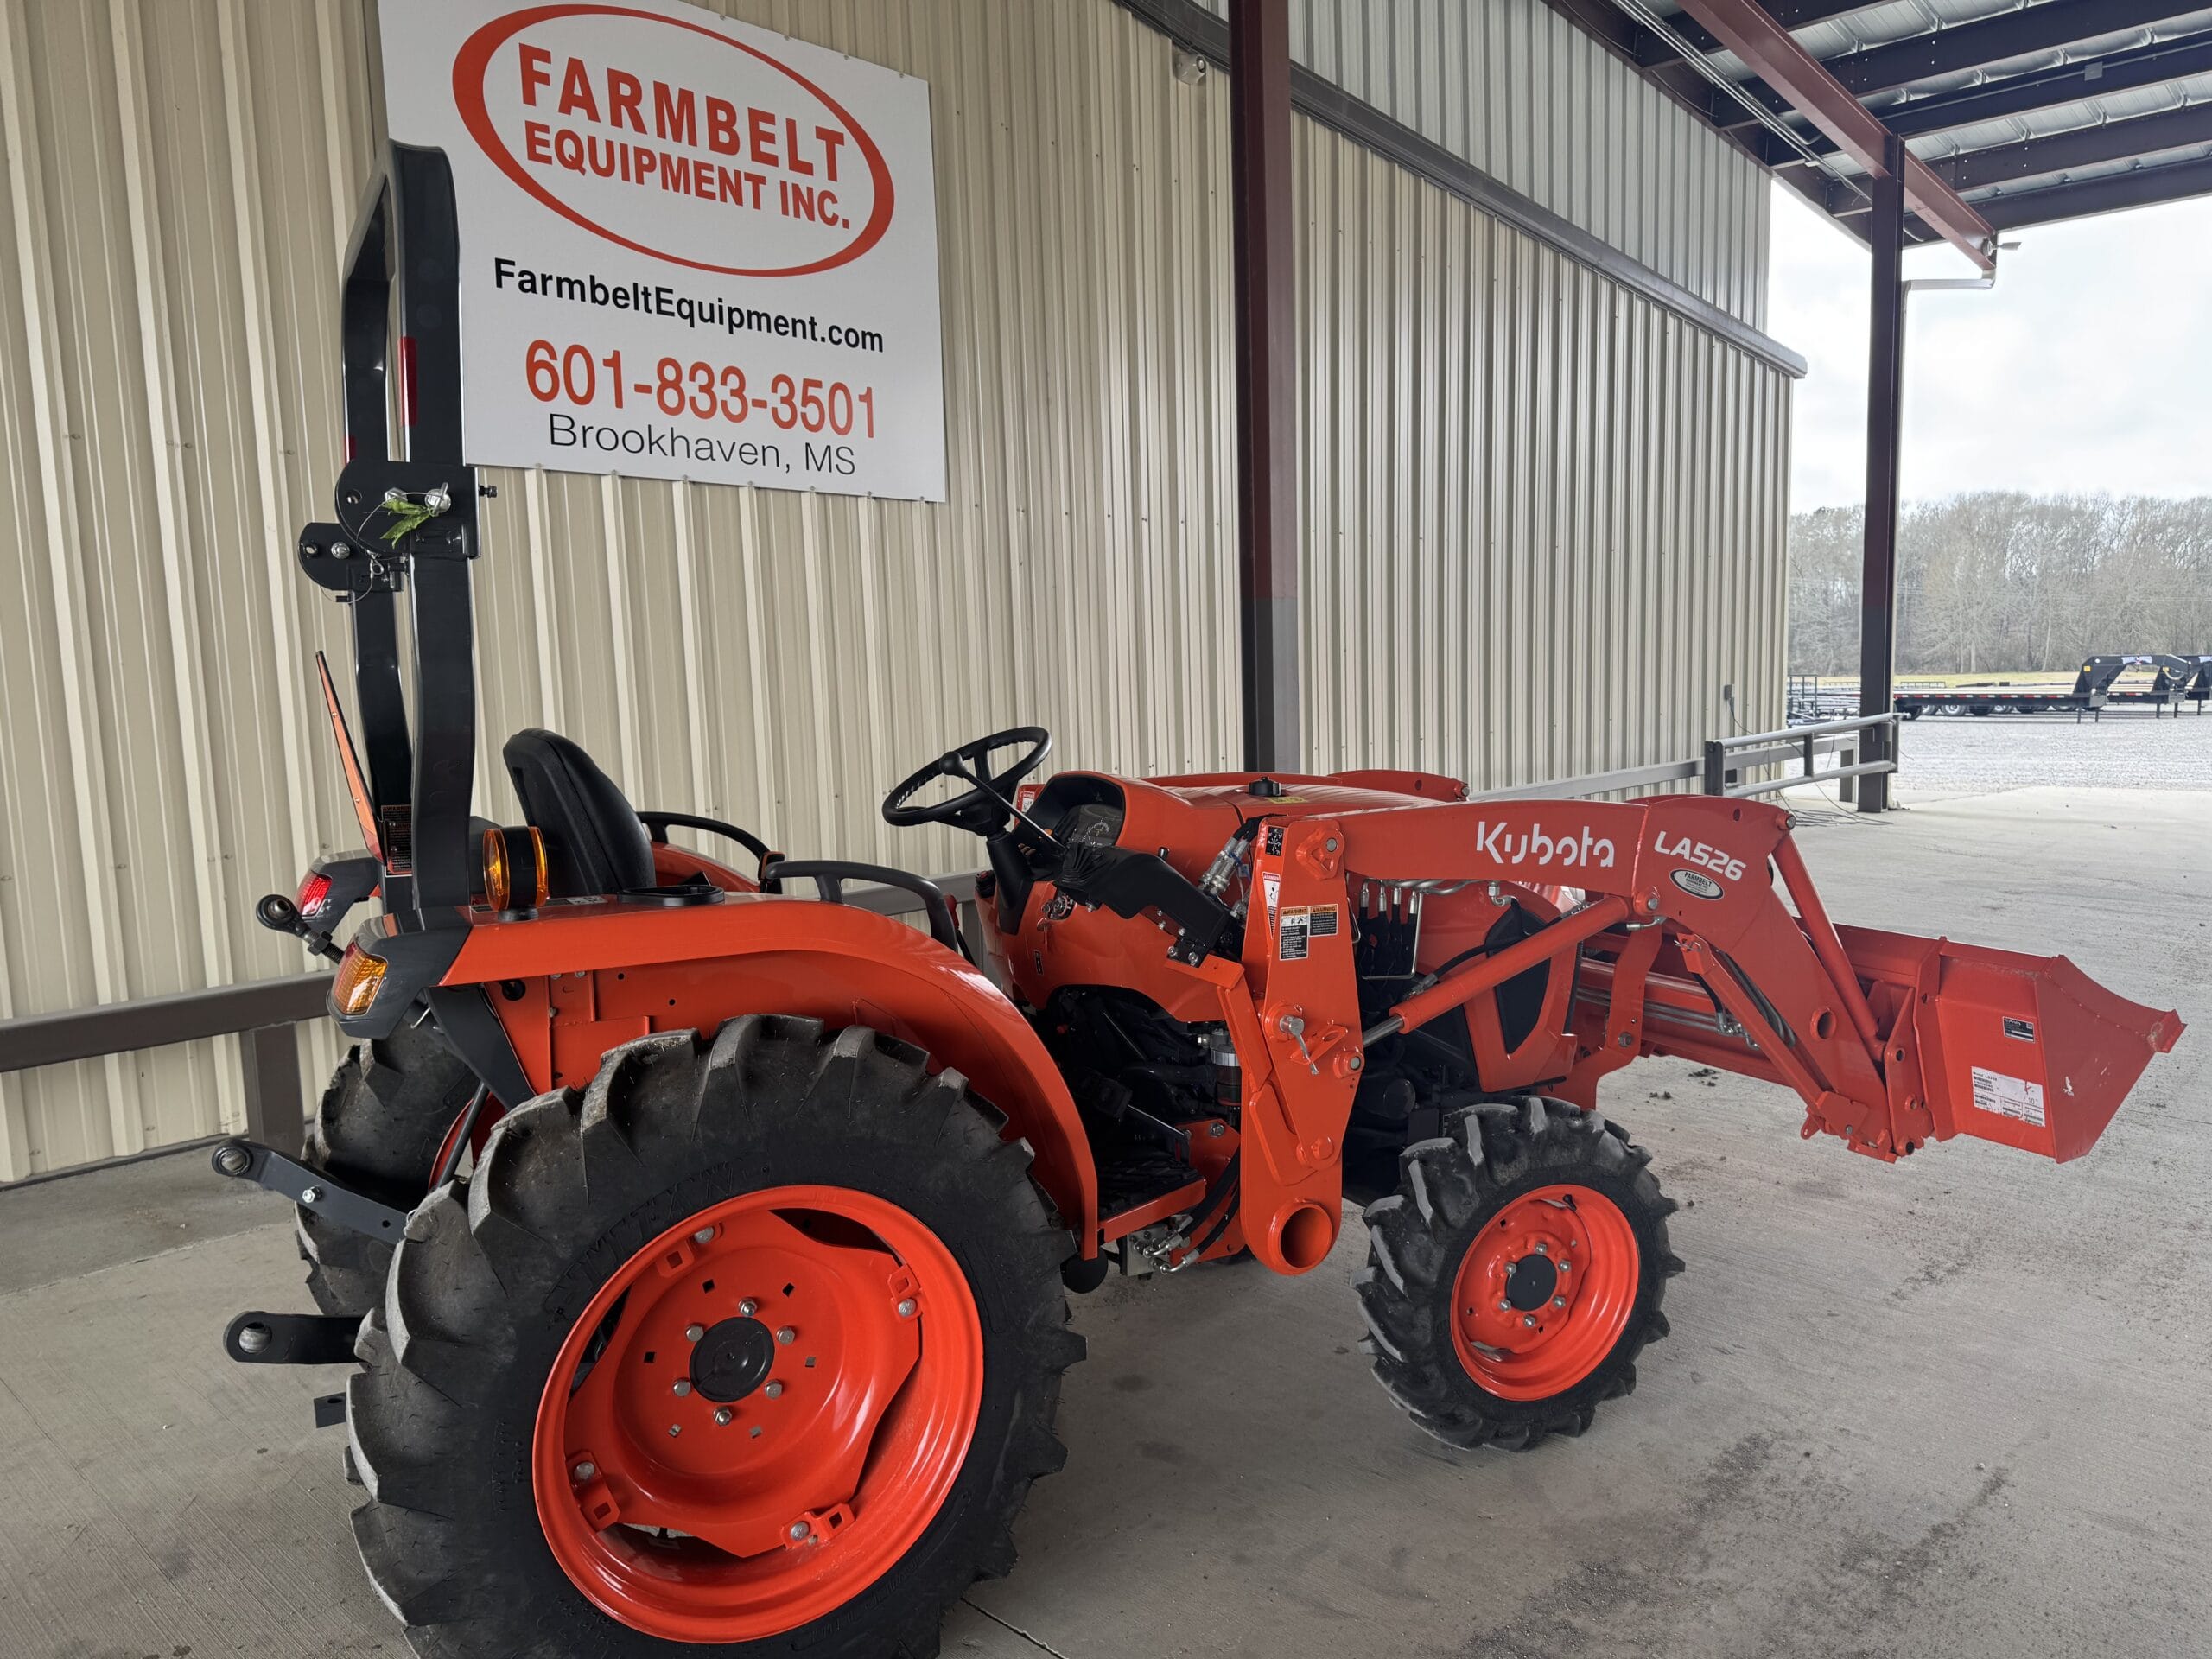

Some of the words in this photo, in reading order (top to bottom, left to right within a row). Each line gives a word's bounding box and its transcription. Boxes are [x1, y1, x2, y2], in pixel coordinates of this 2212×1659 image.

[519, 43, 845, 181] FARMBELT
[524, 121, 766, 210] EQUIPMENT
[779, 180, 849, 229] INC.
[494, 257, 884, 353] FarmbeltEquipment.com
[525, 339, 874, 438] 601-833-3501
[550, 413, 791, 474] Brookhaven,
[804, 442, 855, 475] MS
[1476, 821, 1615, 867] Kubota
[1654, 830, 1747, 881] LA526
[1685, 871, 1712, 887] FARMBELT
